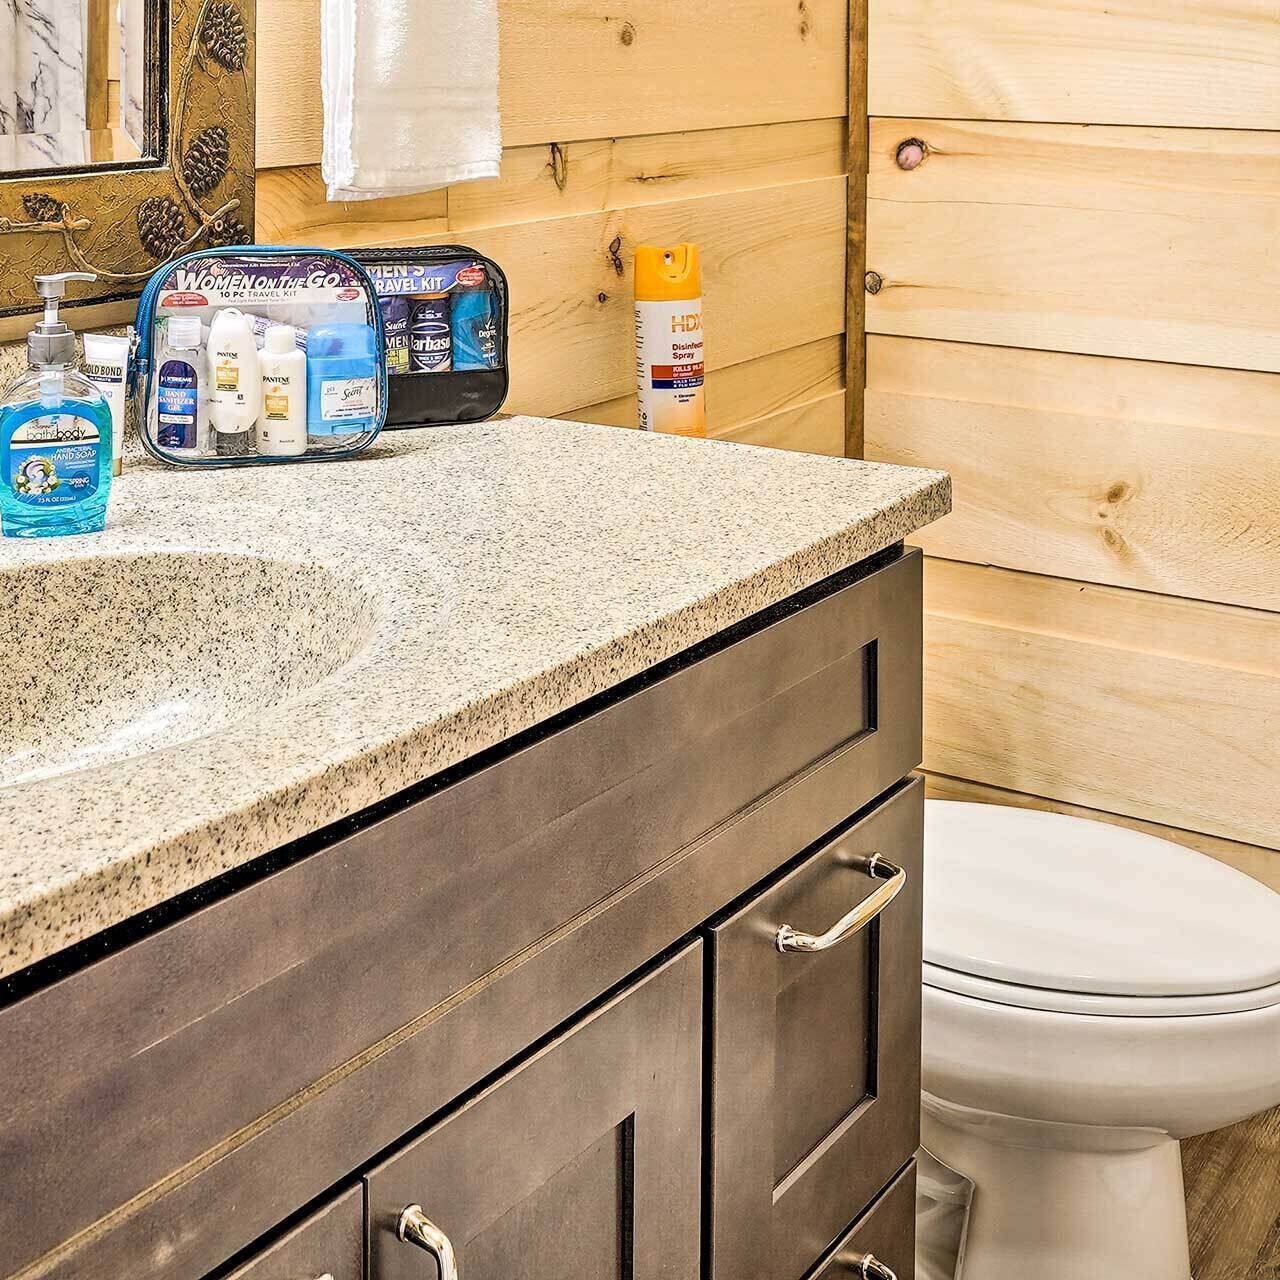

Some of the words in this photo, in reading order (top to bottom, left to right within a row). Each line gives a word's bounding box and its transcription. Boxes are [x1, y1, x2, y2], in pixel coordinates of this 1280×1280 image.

[175, 269, 255, 290] WOMEN
[255, 275, 278, 289] ON
[277, 275, 307, 289] THE
[305, 269, 341, 289] GO
[422, 277, 445, 291] KIT
[672, 314, 704, 333] HDX
[385, 336, 408, 349] MEN
[411, 336, 450, 351] arbaso
[672, 351, 695, 360] Spray
[101, 366, 122, 376] BOND
[165, 390, 186, 398] HAND
[341, 385, 364, 400] Secret
[159, 397, 195, 405] SANITIZER
[51, 452, 74, 461] HAND
[76, 450, 97, 459] SOAP
[69, 477, 90, 485] SPRING
